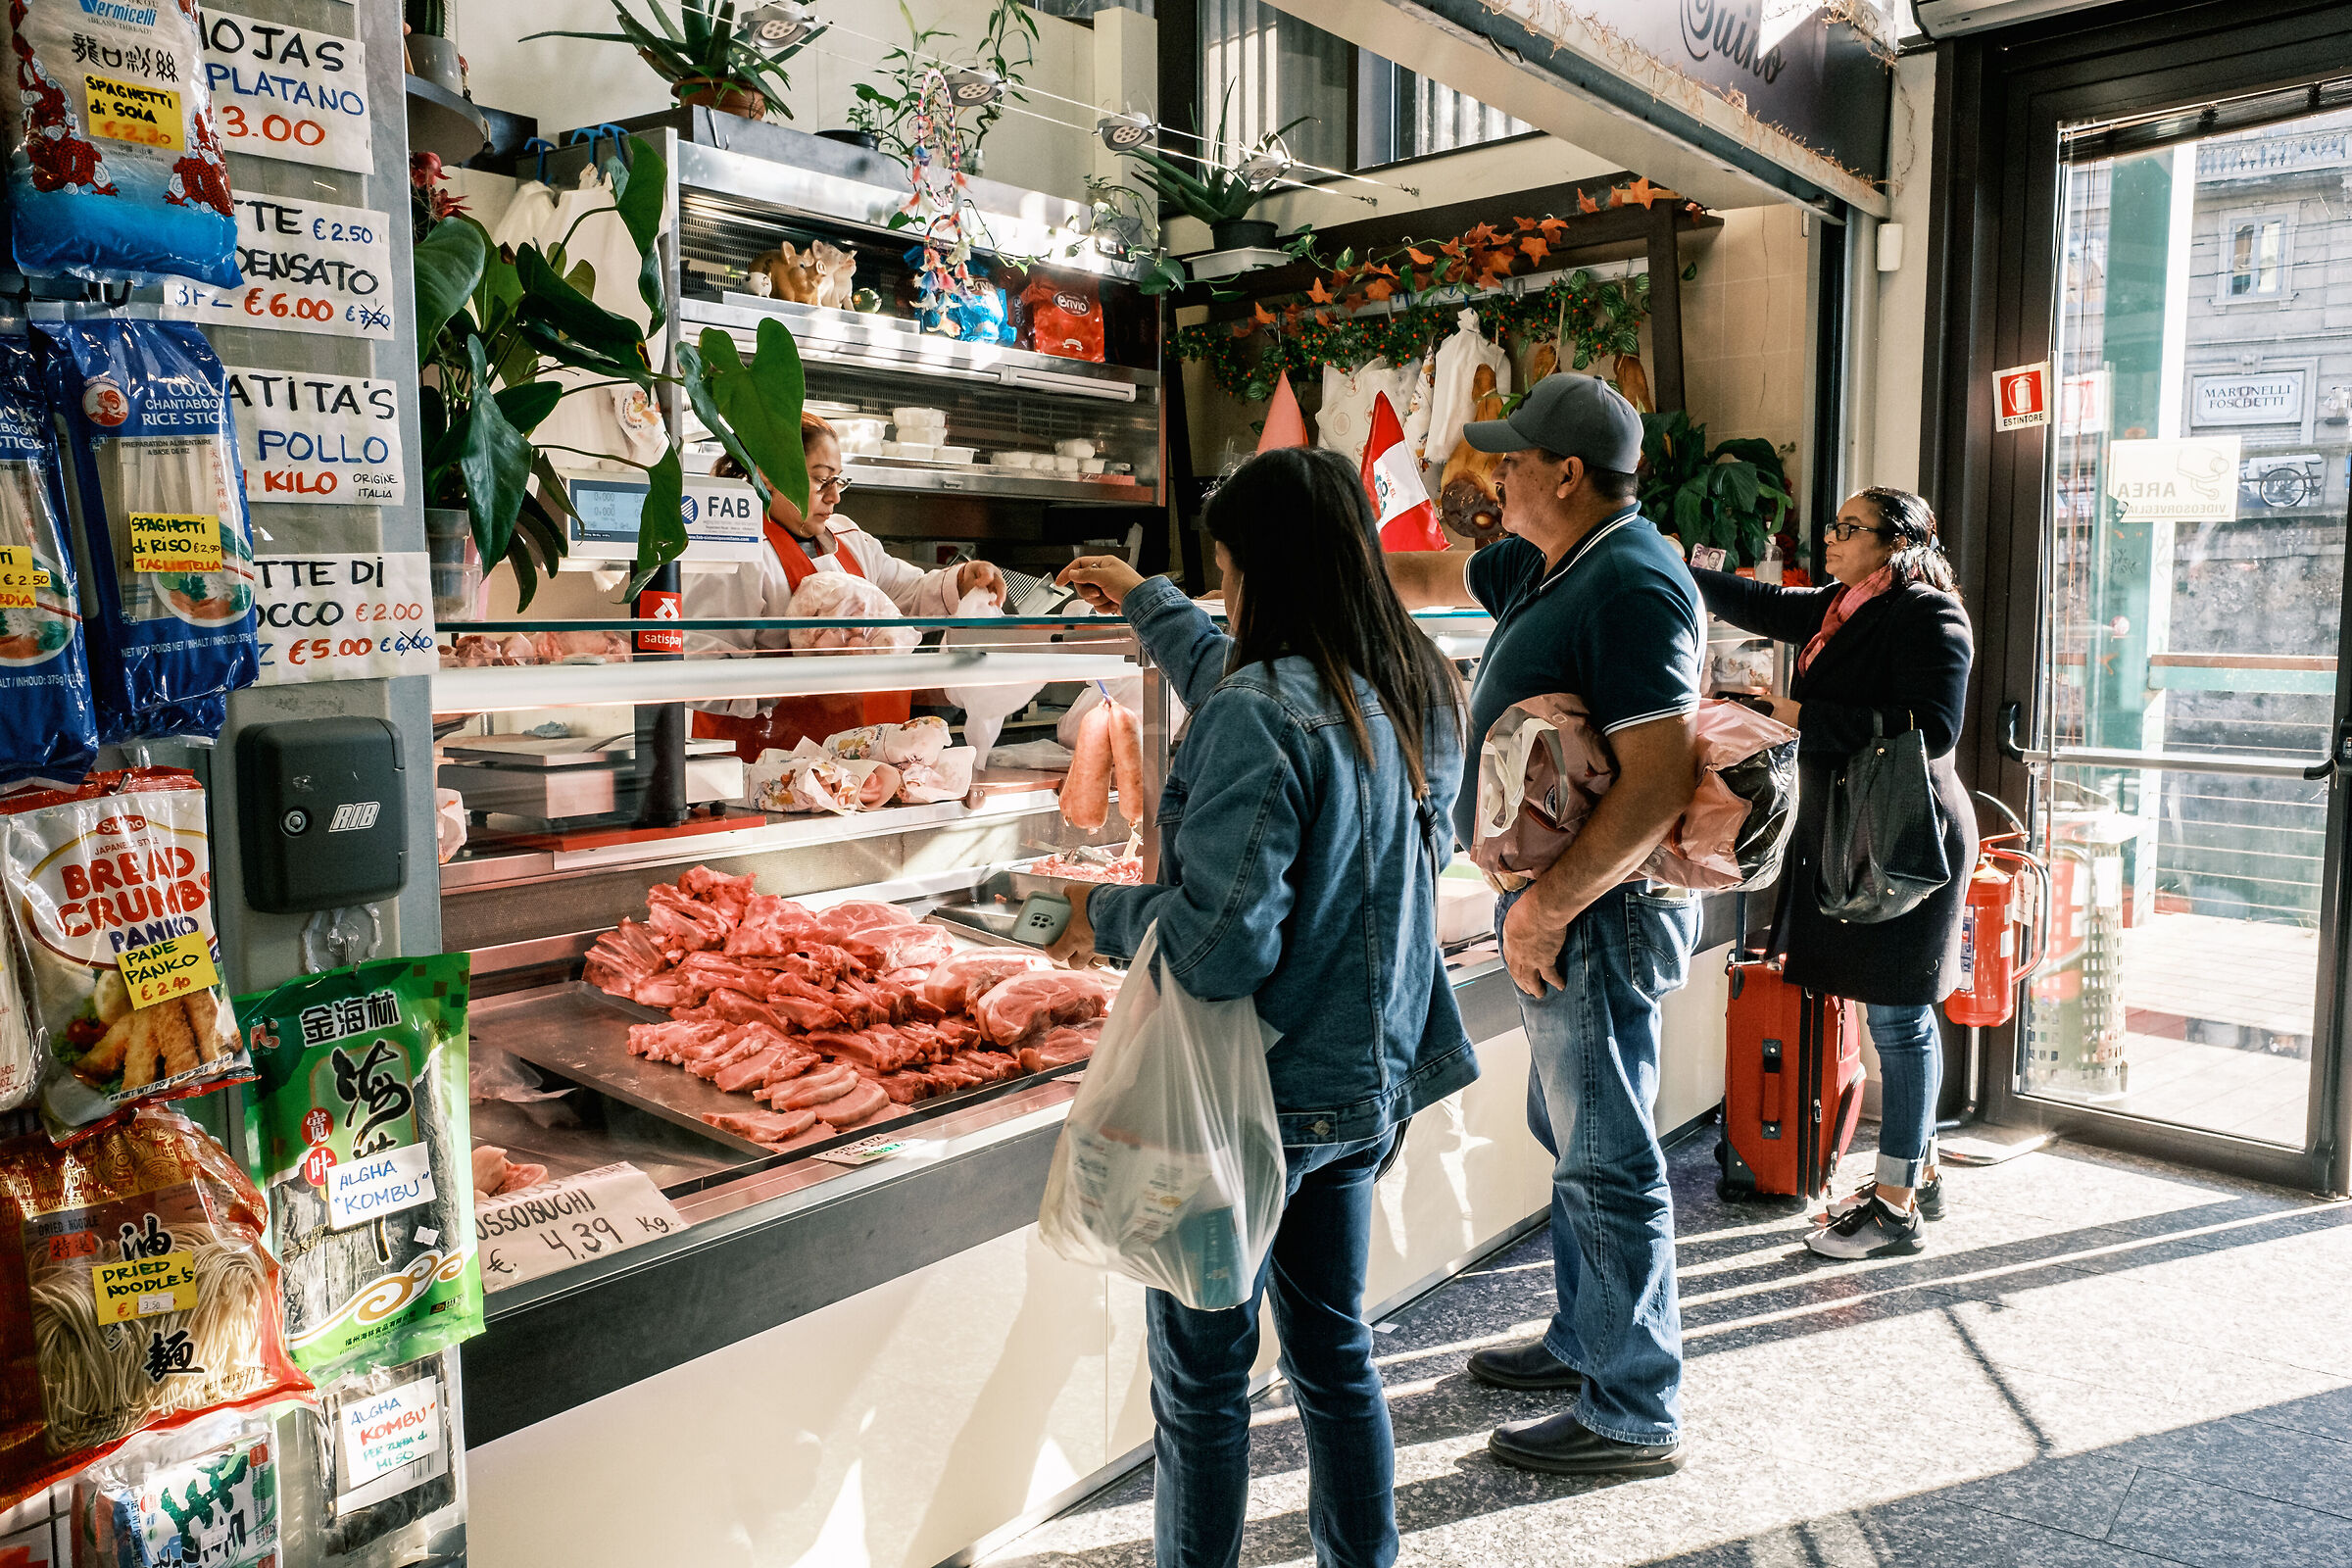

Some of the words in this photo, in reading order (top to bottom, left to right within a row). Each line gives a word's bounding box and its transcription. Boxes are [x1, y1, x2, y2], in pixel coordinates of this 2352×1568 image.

[205, 63, 365, 116] PLATANO
[2204, 384, 2291, 399] MARTINELLI
[141, 412, 179, 425] RICE
[184, 411, 228, 424] STICK
[2003, 413, 2043, 428] ESTINTORE
[121, 440, 169, 449] PREPARATION
[169, 438, 213, 447] ALIMENTAIRE
[258, 429, 389, 465] POLLO
[708, 496, 751, 518] FAB
[172, 640, 184, 651] NET
[16, 674, 46, 687] INHOUD:
[328, 802, 380, 832] RIB
[61, 847, 195, 901] BREAD
[109, 915, 199, 954] PANKO
[125, 940, 178, 966] PANE
[124, 954, 200, 986] PANKO
[301, 992, 400, 1046] 金海林
[120, 1089, 135, 1100] NET
[136, 1085, 149, 1096] WT
[339, 1159, 398, 1190] ALGHA
[39, 1223, 64, 1237] DRIED
[539, 1217, 623, 1260] 4,39
[117, 1301, 130, 1318] €
[351, 1396, 402, 1426] ALGHA
